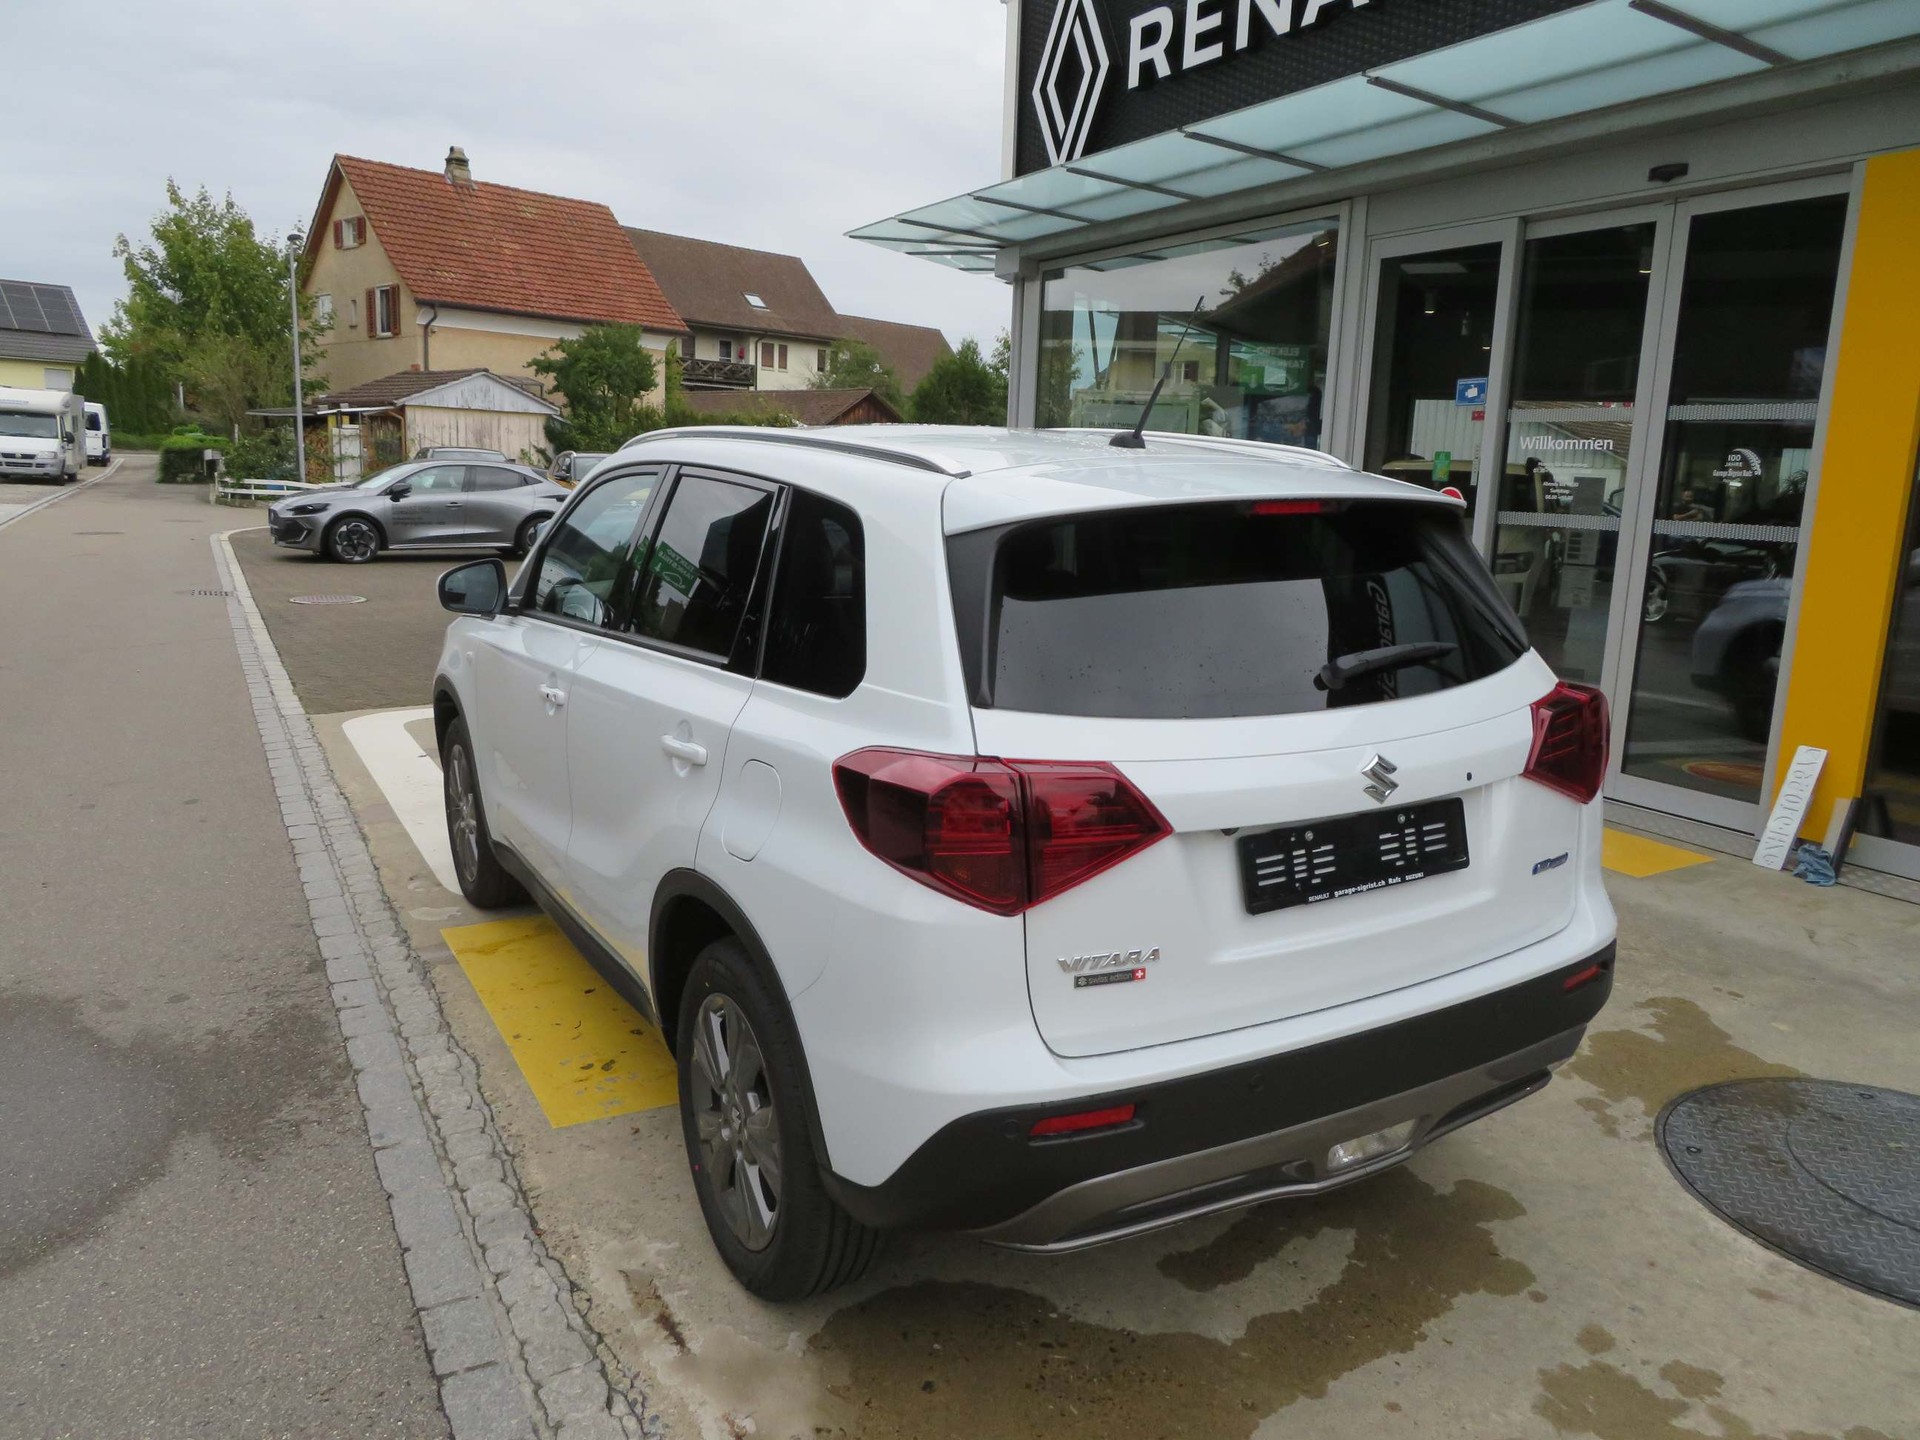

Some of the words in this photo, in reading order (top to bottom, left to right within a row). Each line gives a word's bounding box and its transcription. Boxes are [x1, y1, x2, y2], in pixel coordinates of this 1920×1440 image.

[1520, 435, 1614, 450] Willkommen
[1308, 892, 1330, 902] RENAULT
[1334, 880, 1386, 898] garage-sigrist.ch
[1405, 872, 1424, 881] SUZUKI
[1057, 945, 1160, 973] VITARA
